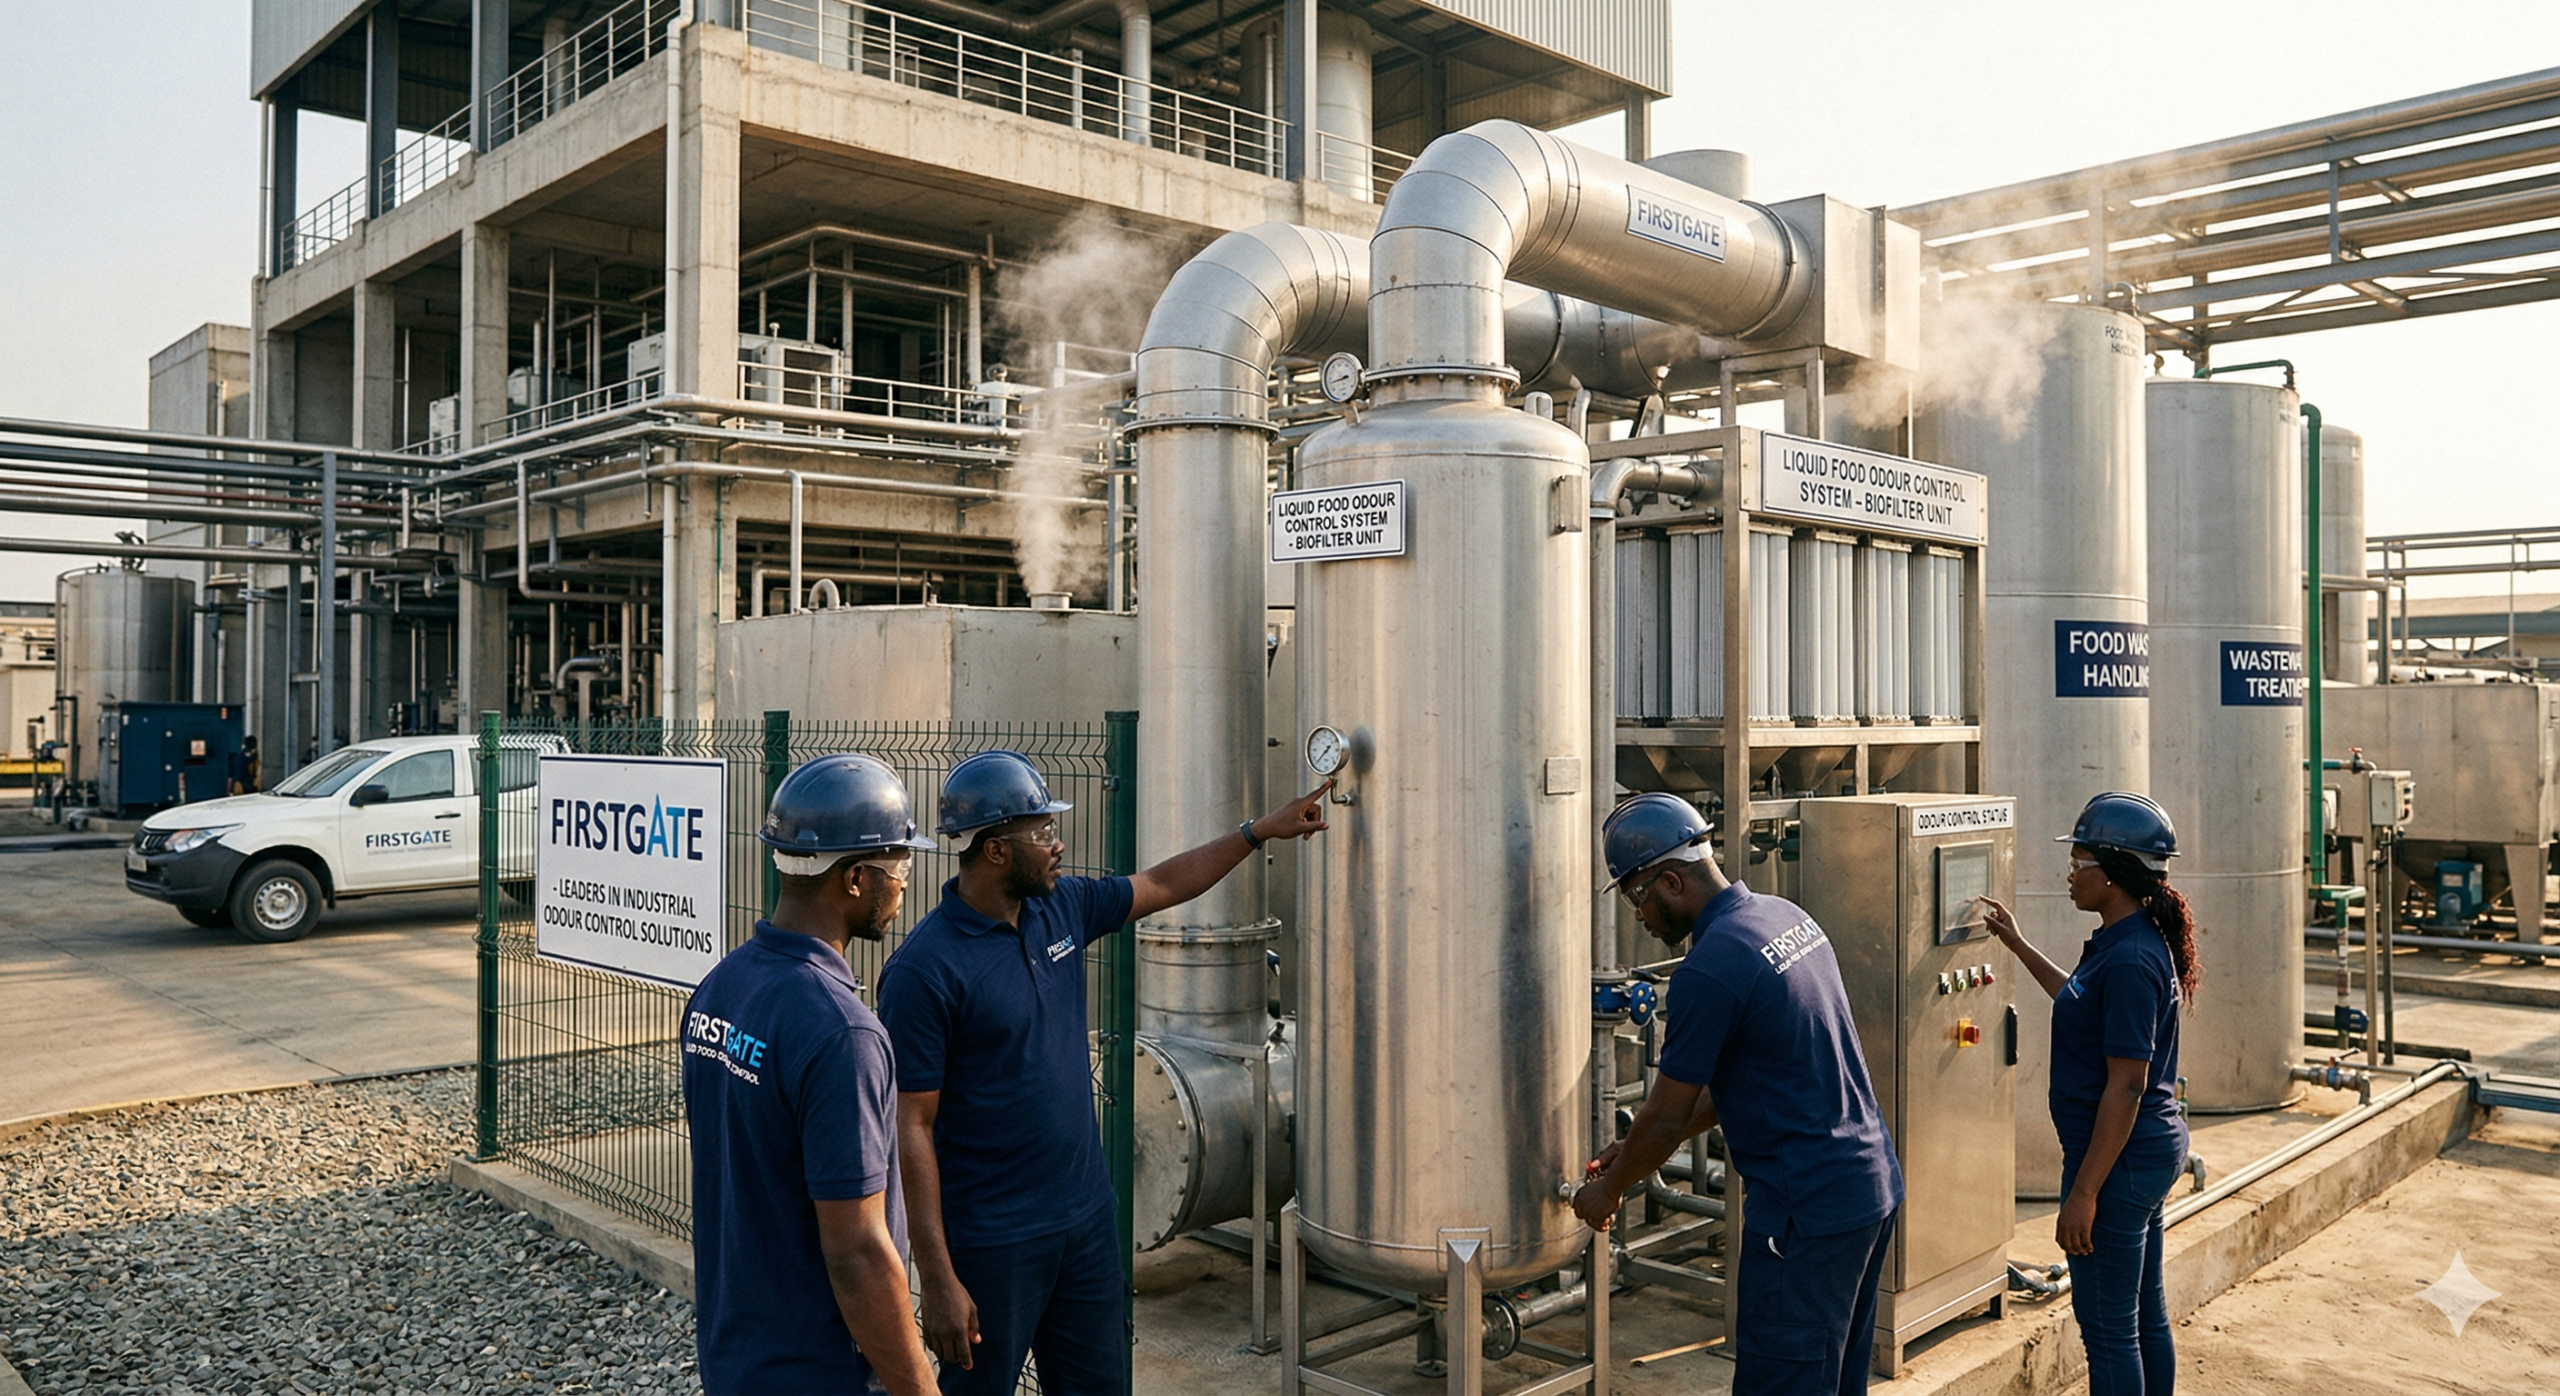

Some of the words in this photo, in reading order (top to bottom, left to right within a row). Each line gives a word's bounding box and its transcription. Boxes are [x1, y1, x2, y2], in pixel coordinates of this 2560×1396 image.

[1638, 199, 1720, 247] FIRSTGATE
[1783, 449, 1828, 475] LIQUID
[1831, 458, 1866, 484] FOOD
[1869, 466, 1911, 492] ODOUR
[1913, 475, 1966, 503] CONTROL
[1279, 500, 1315, 517] LIQUID
[1318, 497, 1349, 513] FOOD
[1352, 492, 1395, 510] ODOUR
[1285, 516, 1338, 533] CONTROL
[1341, 511, 1388, 528] SYSTEM
[1800, 481, 1852, 509] SYSTEM
[1865, 492, 1924, 522] BIOFILTER
[1927, 504, 1952, 526] UNIT
[1296, 532, 1353, 550] BIOFILTER
[1356, 529, 1383, 545] UNIT
[2069, 630, 2125, 655] FOOD
[366, 829, 451, 848] FIRSTGATE
[552, 793, 703, 861] FIRSTGATE
[559, 878, 606, 904] LEADERS
[608, 885, 621, 907] IN
[623, 888, 696, 918] INDUSTRIAL
[544, 905, 582, 930] ODOUR
[585, 911, 638, 941] CONTROL
[641, 921, 712, 954] SOLUTIONS
[687, 1011, 767, 1068] FIRSTGATE
